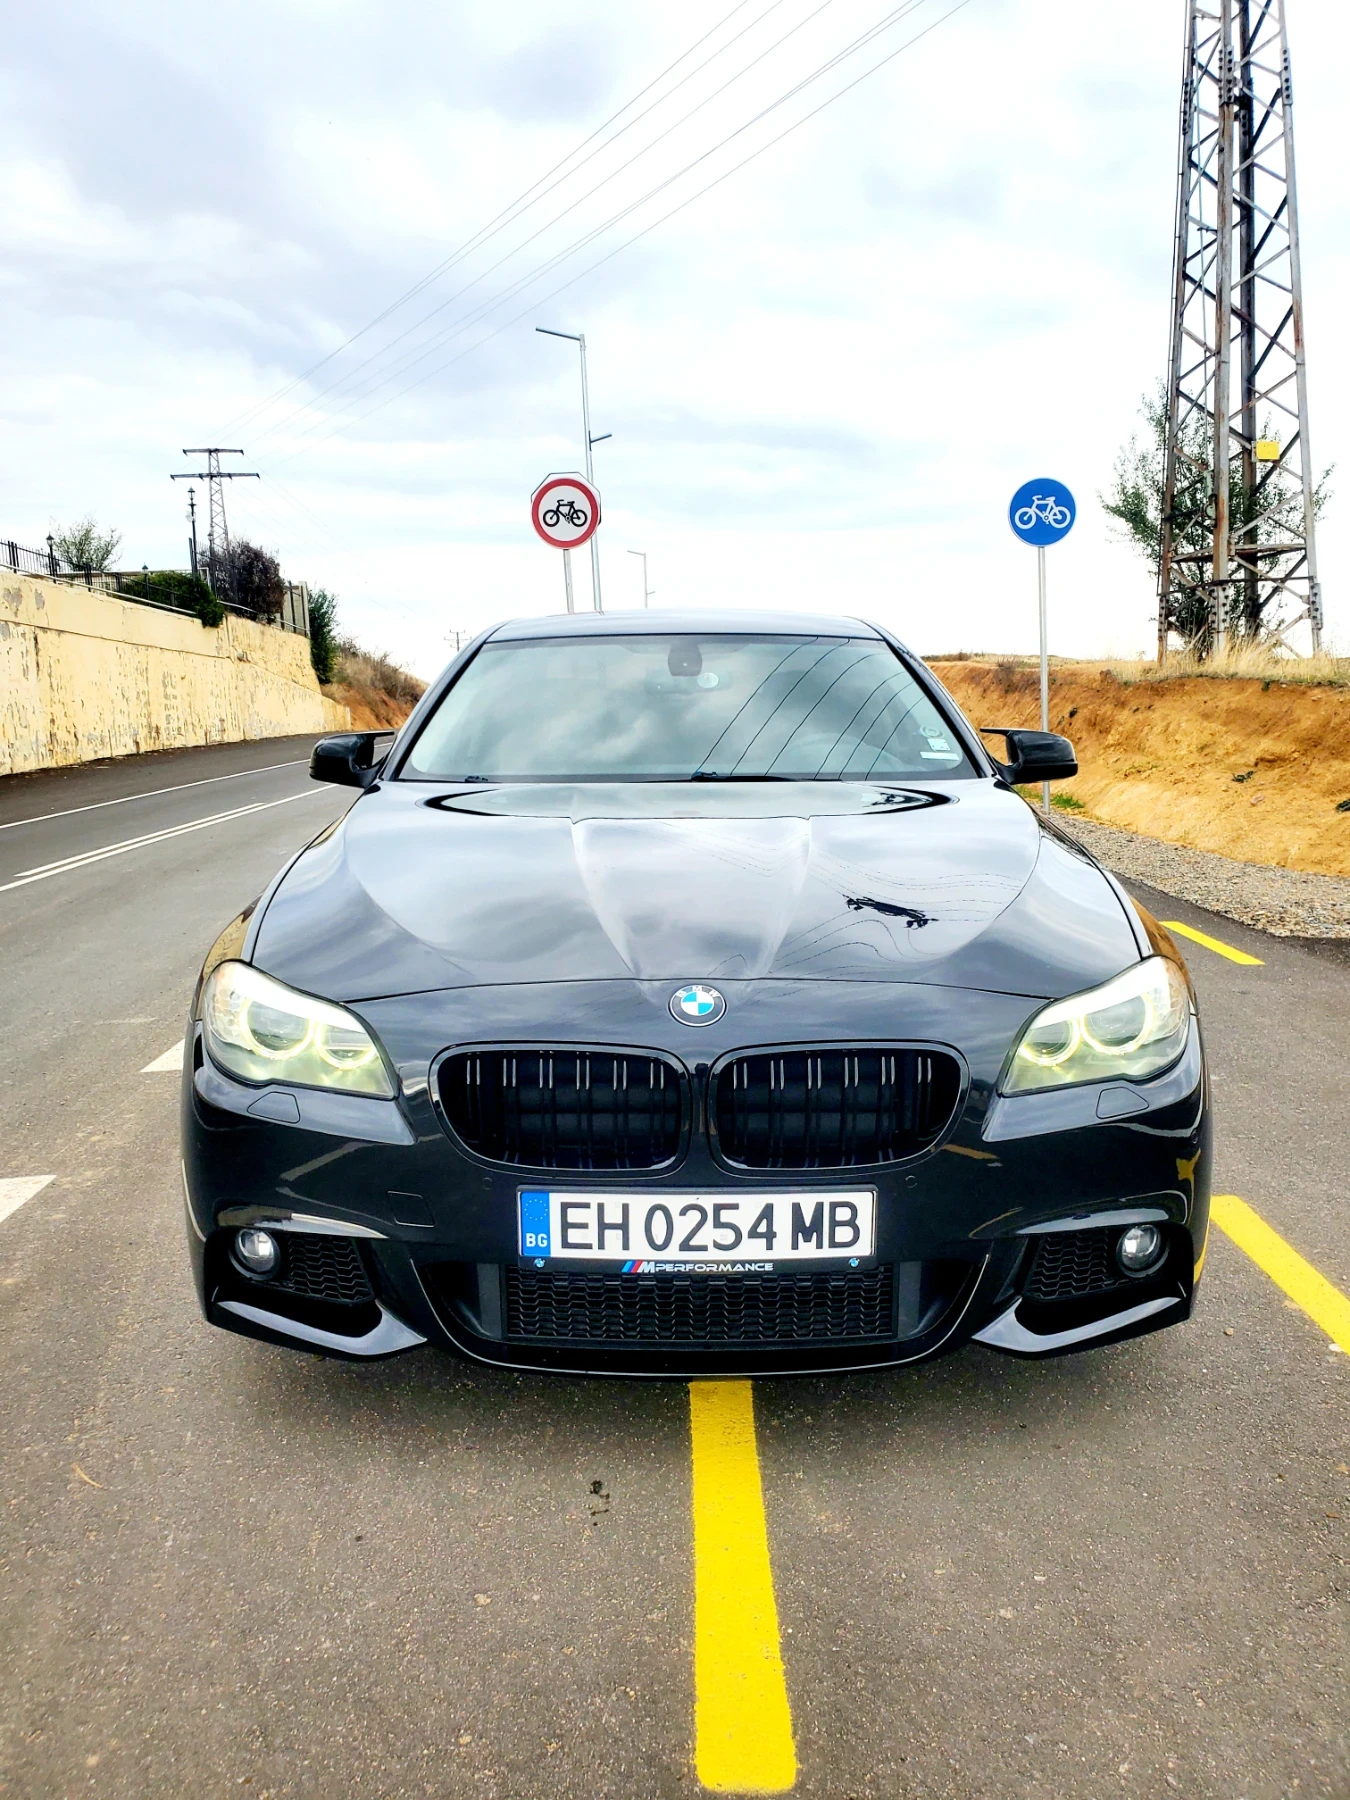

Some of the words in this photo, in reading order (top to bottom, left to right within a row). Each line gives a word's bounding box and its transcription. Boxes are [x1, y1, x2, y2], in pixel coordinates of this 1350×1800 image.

[525, 1232, 548, 1248] BG
[560, 1201, 631, 1251] EH
[644, 1202, 778, 1252] 0254
[791, 1201, 861, 1250] MB
